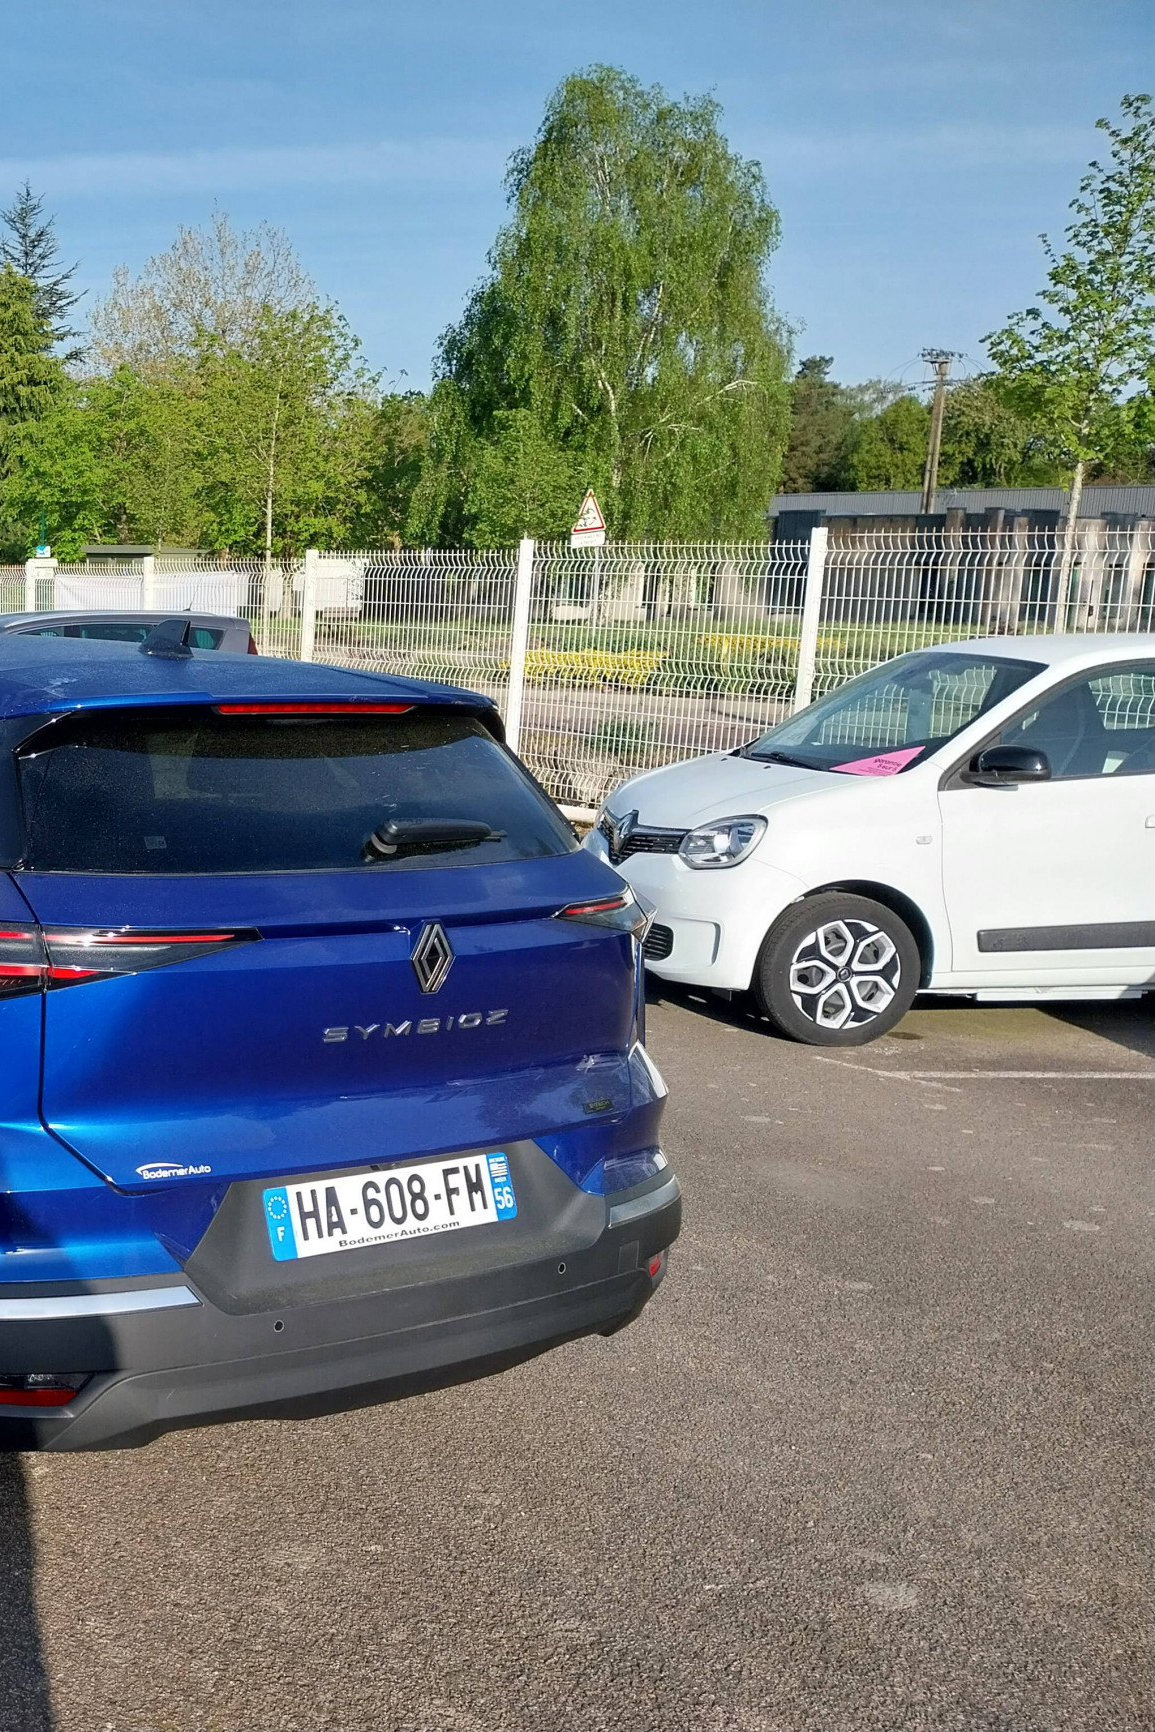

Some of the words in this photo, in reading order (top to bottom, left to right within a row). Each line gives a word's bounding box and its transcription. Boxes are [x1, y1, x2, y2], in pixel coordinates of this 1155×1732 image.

[323, 1009, 509, 1043] SYMBIOZ
[142, 1164, 212, 1180] BodemerAuto
[296, 1163, 488, 1241] HA-608-FM
[494, 1186, 514, 1210] 56
[276, 1226, 285, 1242] F
[338, 1219, 461, 1248] BodemerAuto.com
